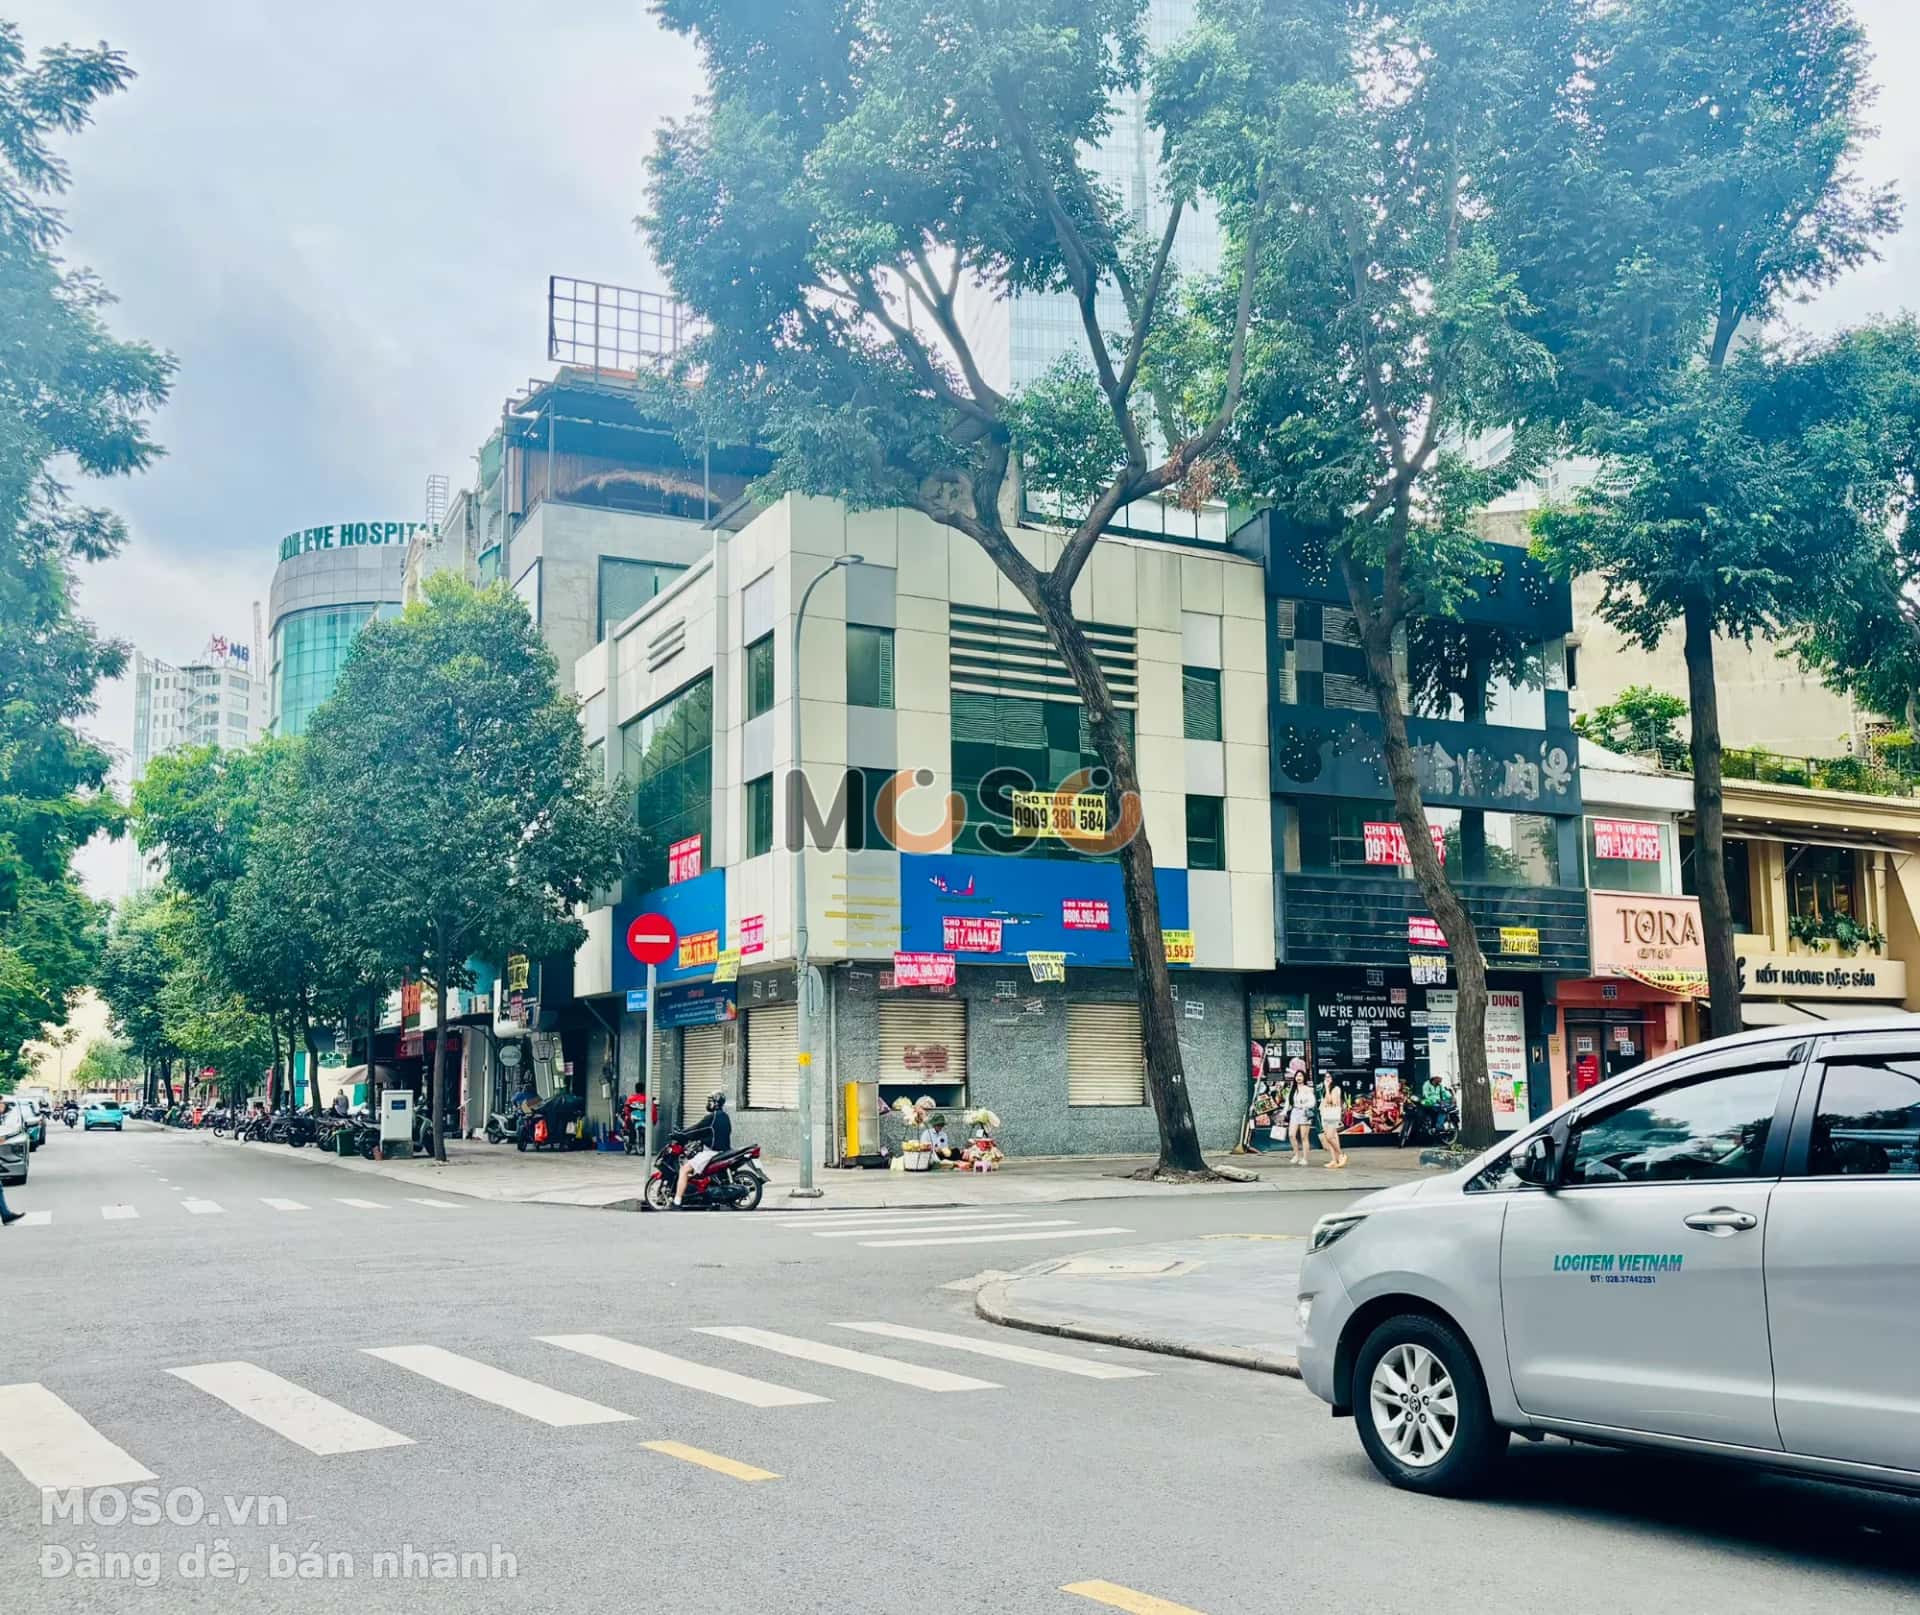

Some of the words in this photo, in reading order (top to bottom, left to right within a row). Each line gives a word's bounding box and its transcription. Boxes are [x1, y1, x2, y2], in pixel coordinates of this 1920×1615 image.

[303, 525, 334, 553] EYE
[1014, 794, 1040, 804] CHO
[1043, 795, 1074, 806] THUÊ
[1080, 809, 1104, 831] 584
[1616, 908, 1700, 946] TORA
[1318, 1005, 1353, 1018] WE'RE
[1358, 1006, 1405, 1018] MOVING
[1553, 1254, 1615, 1271] LOGITEM
[1618, 1254, 1683, 1272] VIETNAM
